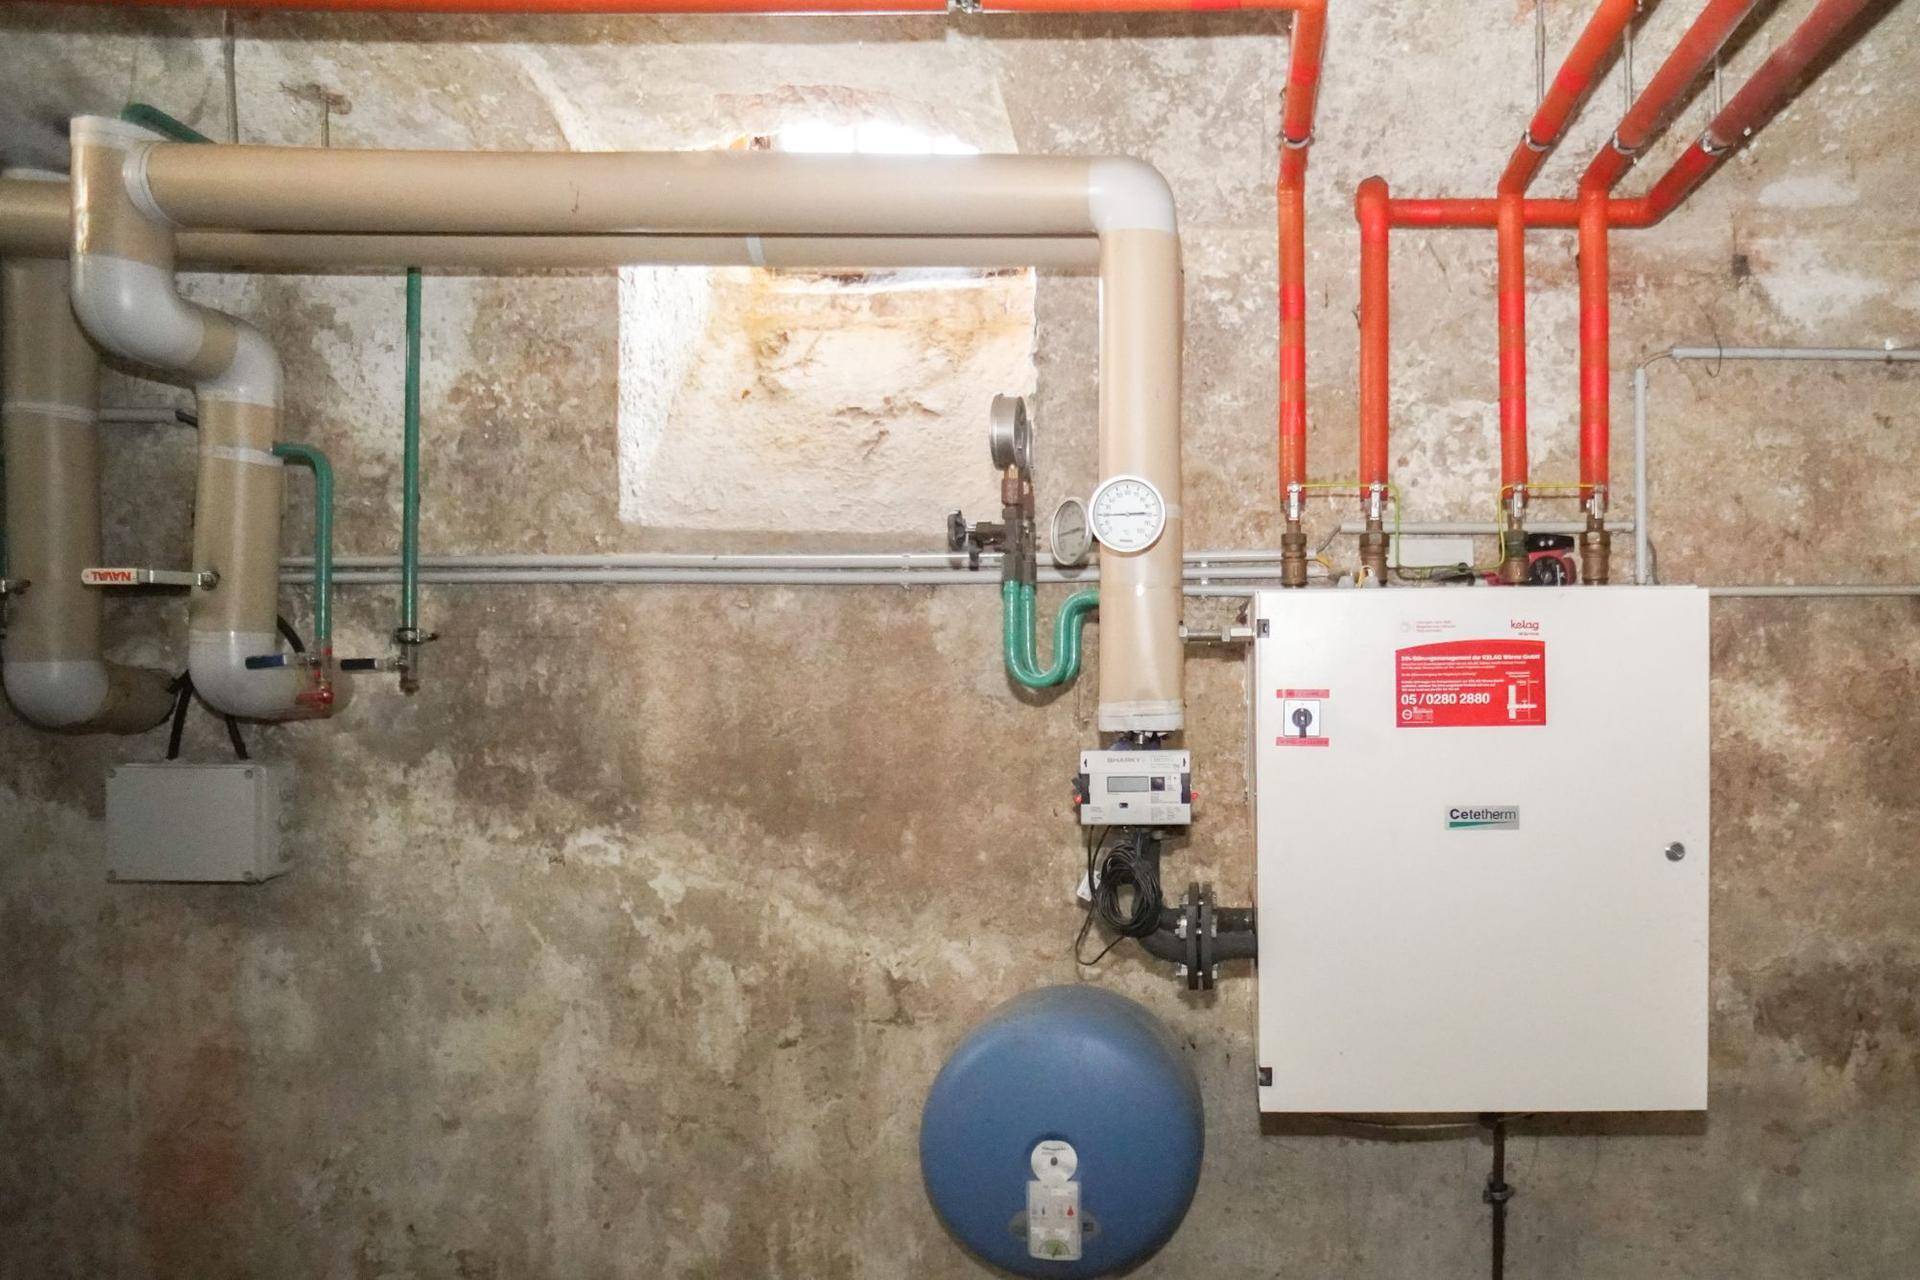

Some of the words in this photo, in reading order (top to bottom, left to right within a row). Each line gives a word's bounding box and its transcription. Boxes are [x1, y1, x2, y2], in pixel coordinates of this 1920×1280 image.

[91, 571, 131, 582] NAVAL
[1510, 619, 1540, 631] kelag
[1401, 693, 1417, 705] 05
[1426, 693, 1457, 704] 0280
[1459, 692, 1490, 704] 2880
[1449, 808, 1517, 820] Cetetherm
